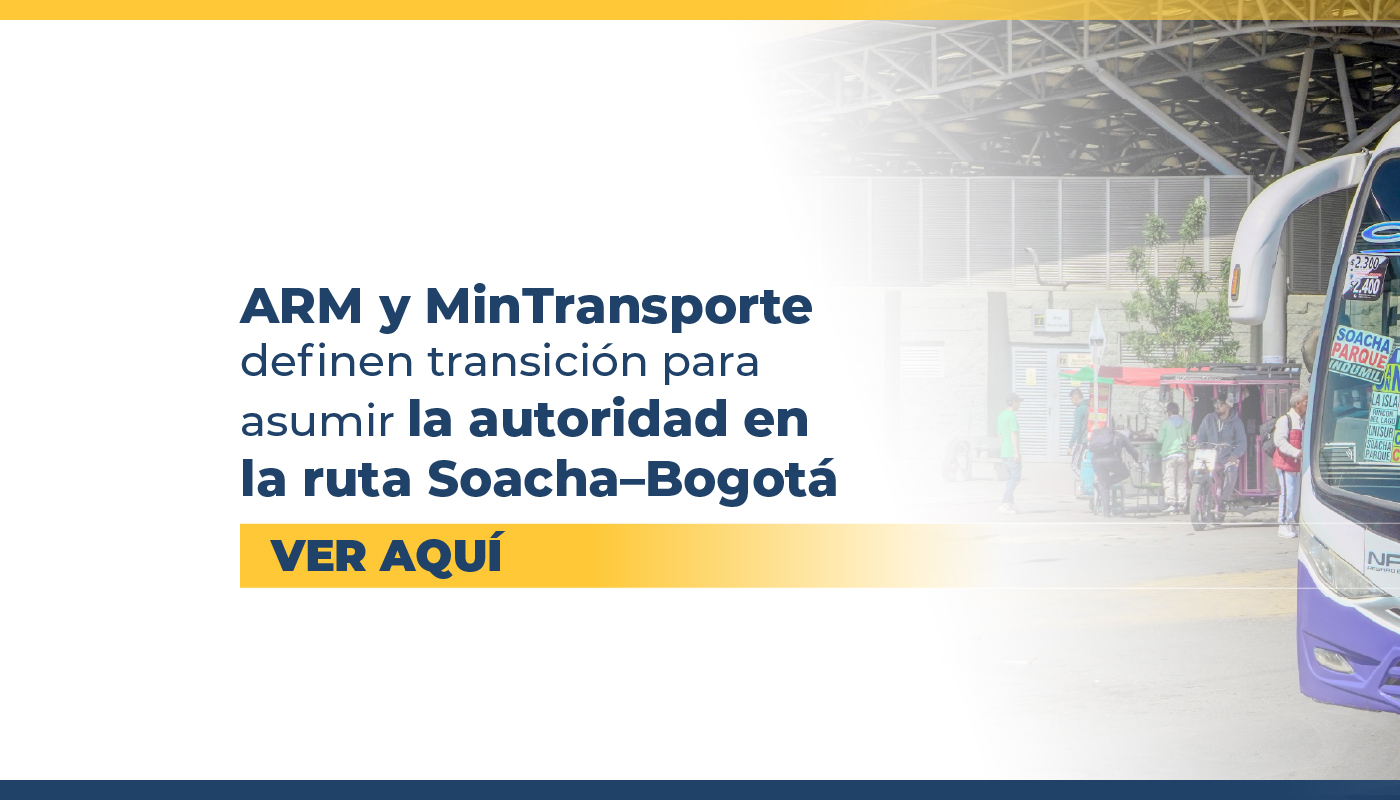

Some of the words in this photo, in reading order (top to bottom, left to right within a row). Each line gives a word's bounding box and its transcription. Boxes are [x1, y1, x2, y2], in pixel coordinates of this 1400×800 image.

[1336, 327, 1390, 354] SOACHA
[1331, 342, 1388, 369] PARQUE
[1329, 360, 1384, 382] INDUMIL
[1372, 392, 1380, 407] LA
[1382, 394, 1398, 408] ISLA
